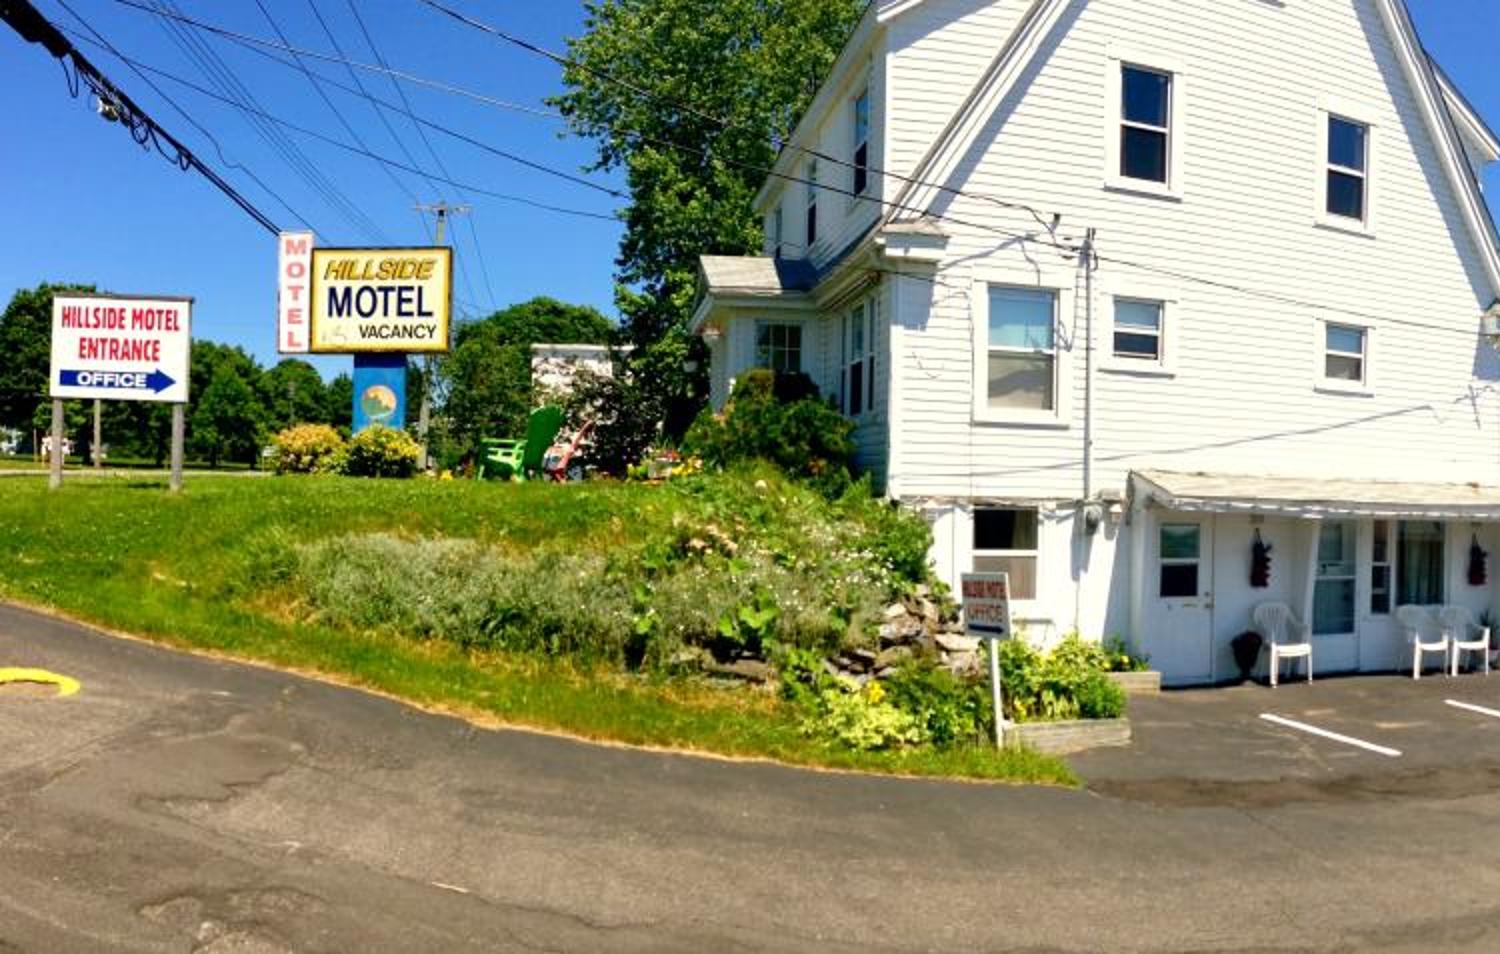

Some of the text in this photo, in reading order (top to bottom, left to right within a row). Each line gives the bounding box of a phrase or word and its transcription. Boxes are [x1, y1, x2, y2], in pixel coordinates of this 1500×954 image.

[323, 259, 437, 281] HILLSIDE
[285, 238, 307, 348] MOTEL
[327, 285, 434, 318] MOTEL
[61, 305, 179, 332] HILLSIDE MOTEL
[358, 323, 437, 339] VACANCY
[78, 336, 161, 362] ENTRANCE
[76, 371, 148, 388] OFFICE
